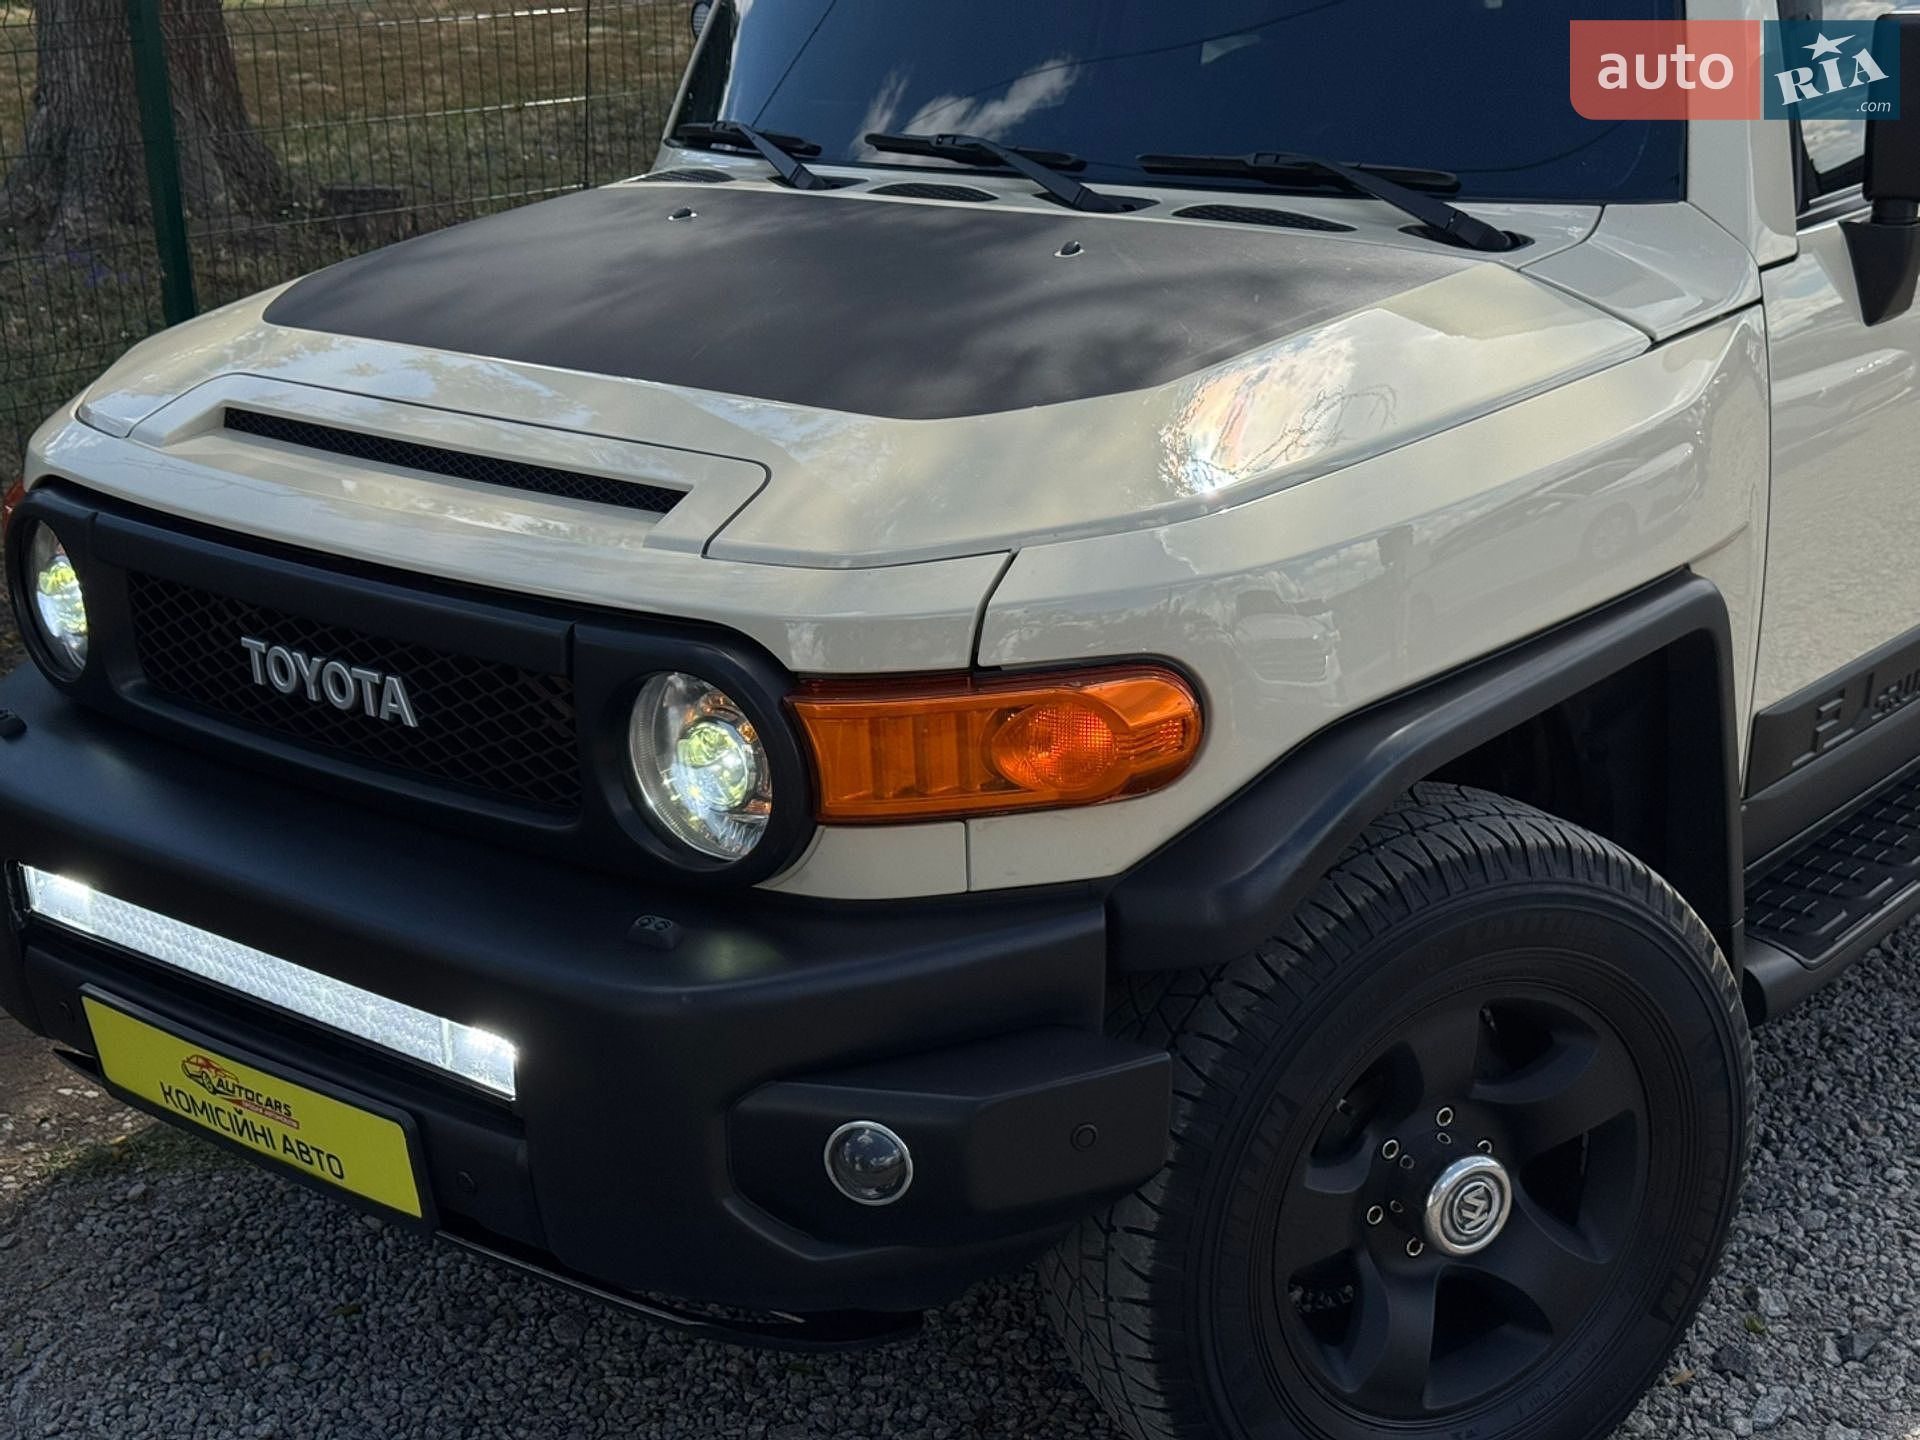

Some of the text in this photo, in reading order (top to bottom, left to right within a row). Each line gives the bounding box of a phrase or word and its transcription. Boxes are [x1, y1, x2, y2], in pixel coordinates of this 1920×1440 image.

[241, 636, 419, 728] TOYOTA
[159, 1081, 276, 1149] КОМІСІЙНІ
[282, 1133, 345, 1180] АВТО
[216, 1078, 292, 1117] AUTOCARS
